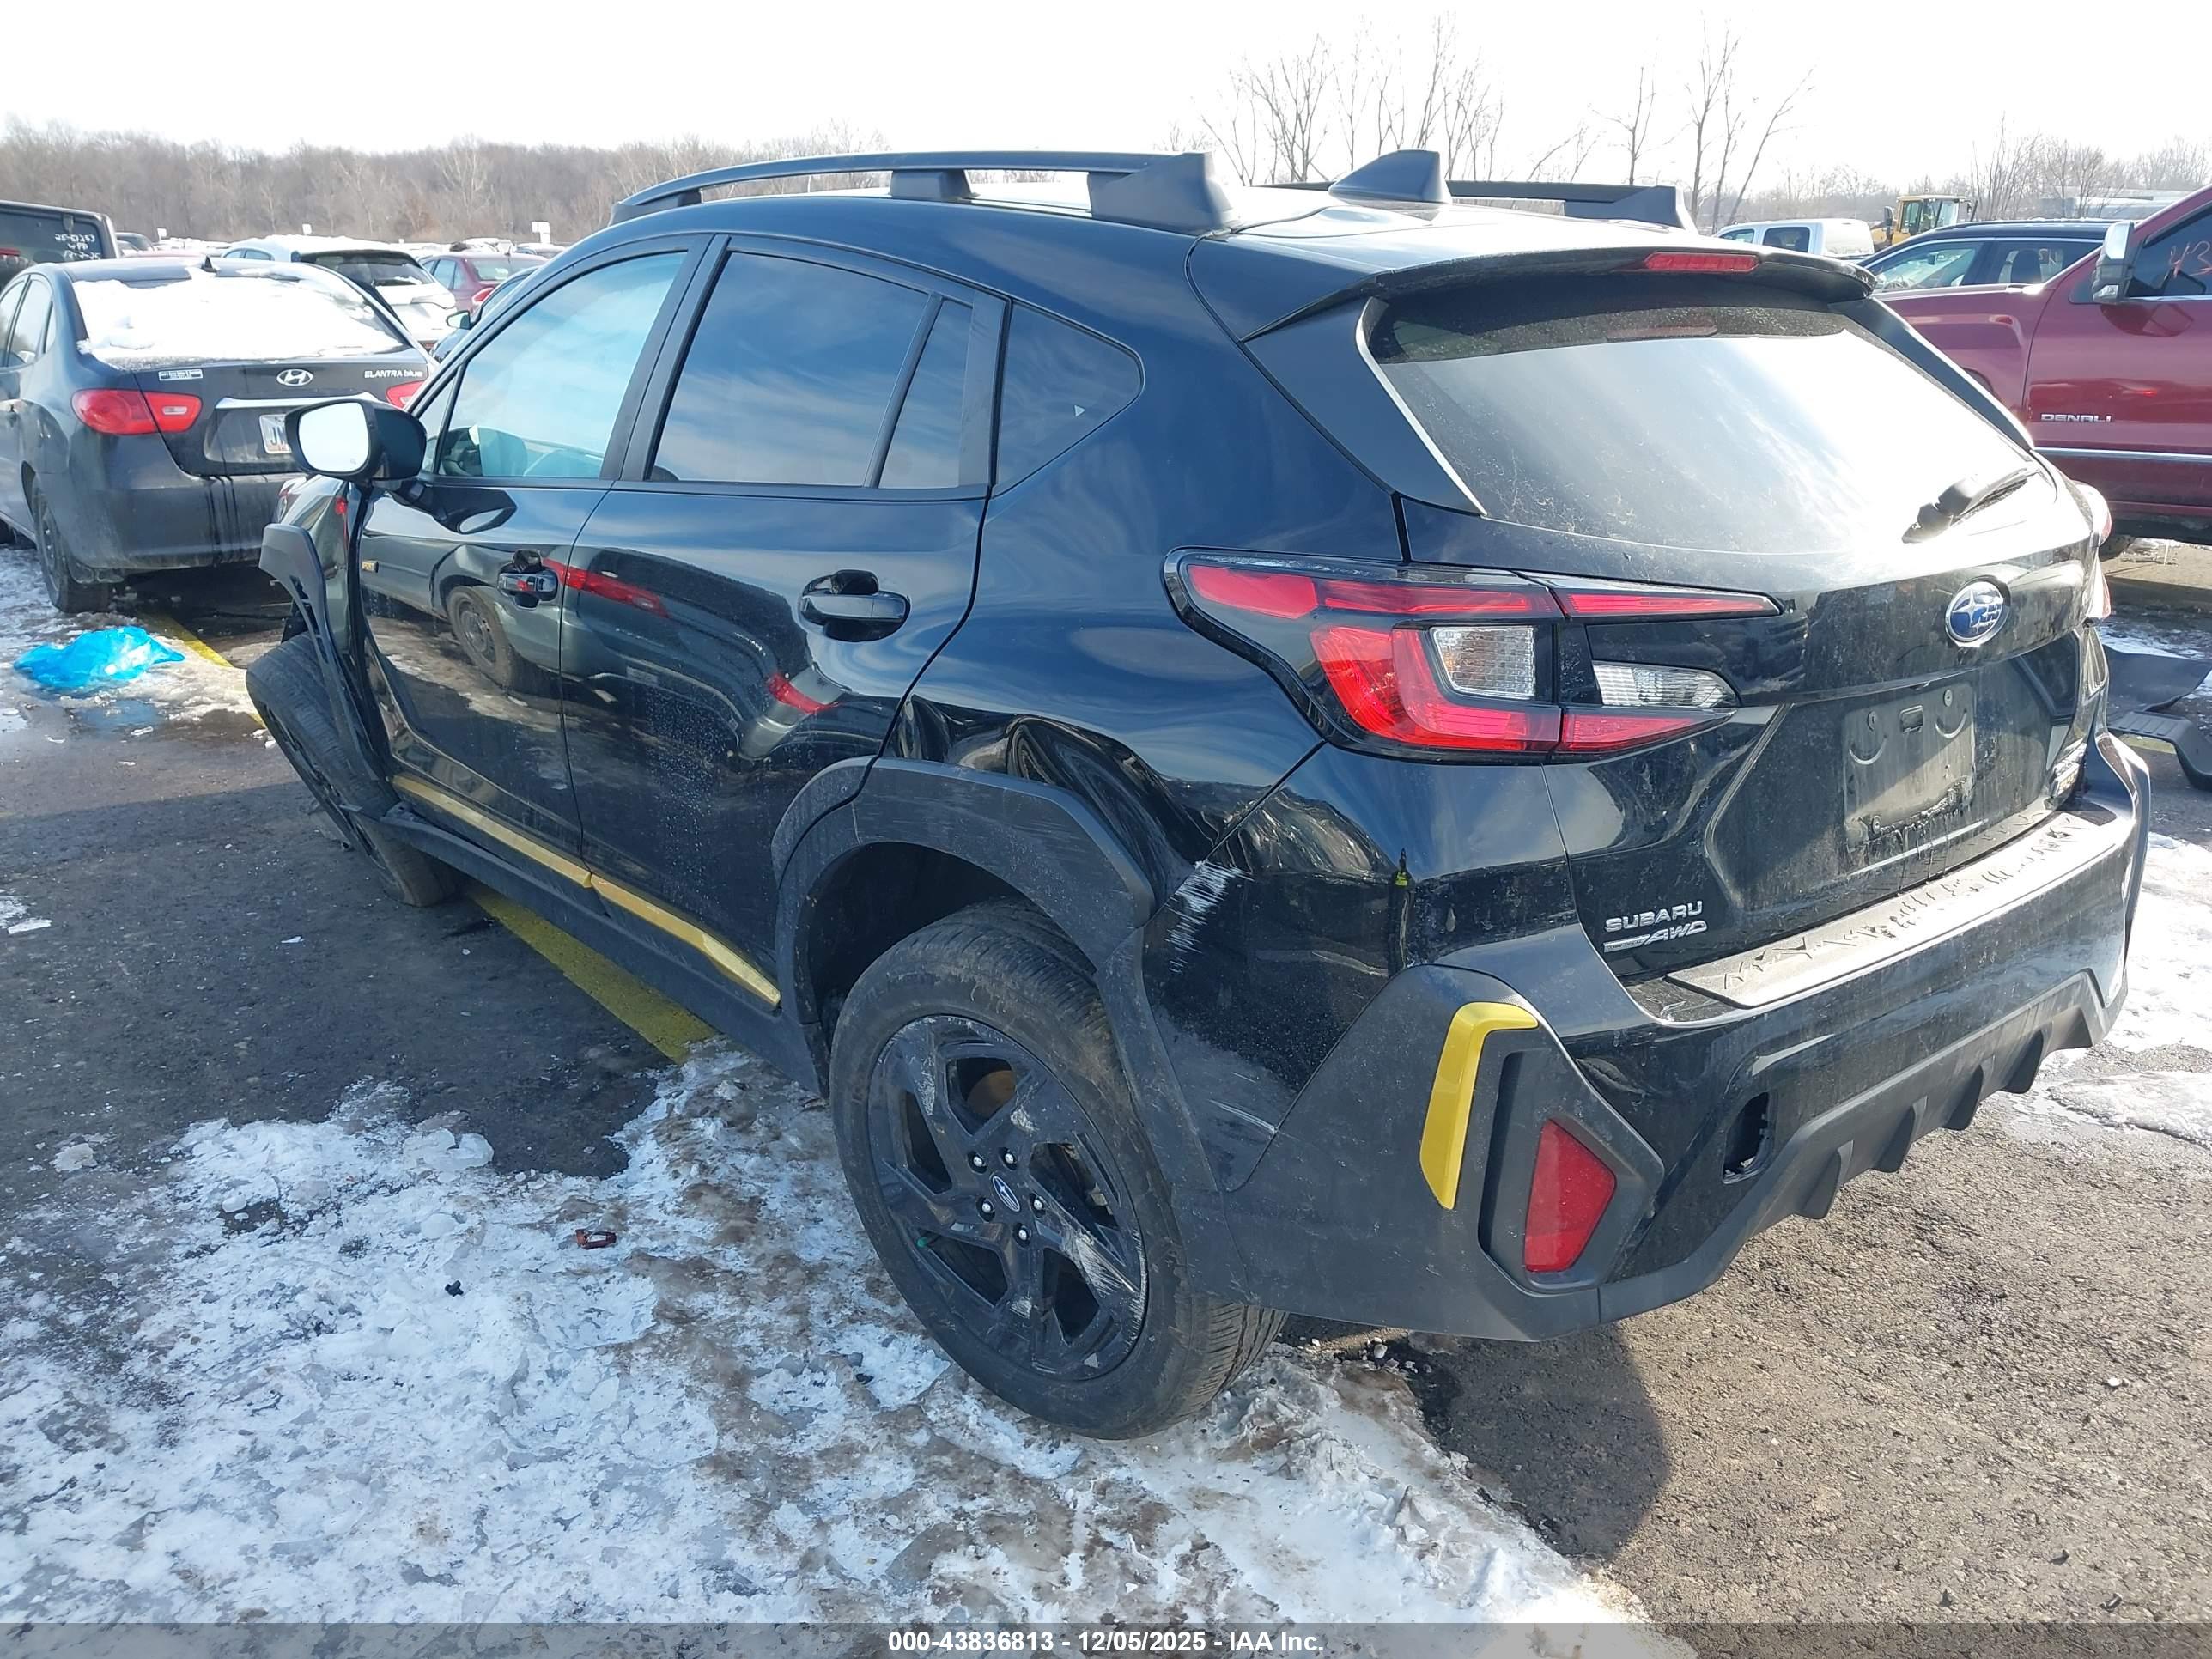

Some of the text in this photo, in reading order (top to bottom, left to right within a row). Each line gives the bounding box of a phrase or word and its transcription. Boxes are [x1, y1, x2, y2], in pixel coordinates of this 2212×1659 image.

[364, 369, 403, 378] ELANTRA
[2040, 414, 2112, 422] DENALI
[1604, 900, 1703, 933] SUBARU
[1644, 920, 1708, 945] AWD
